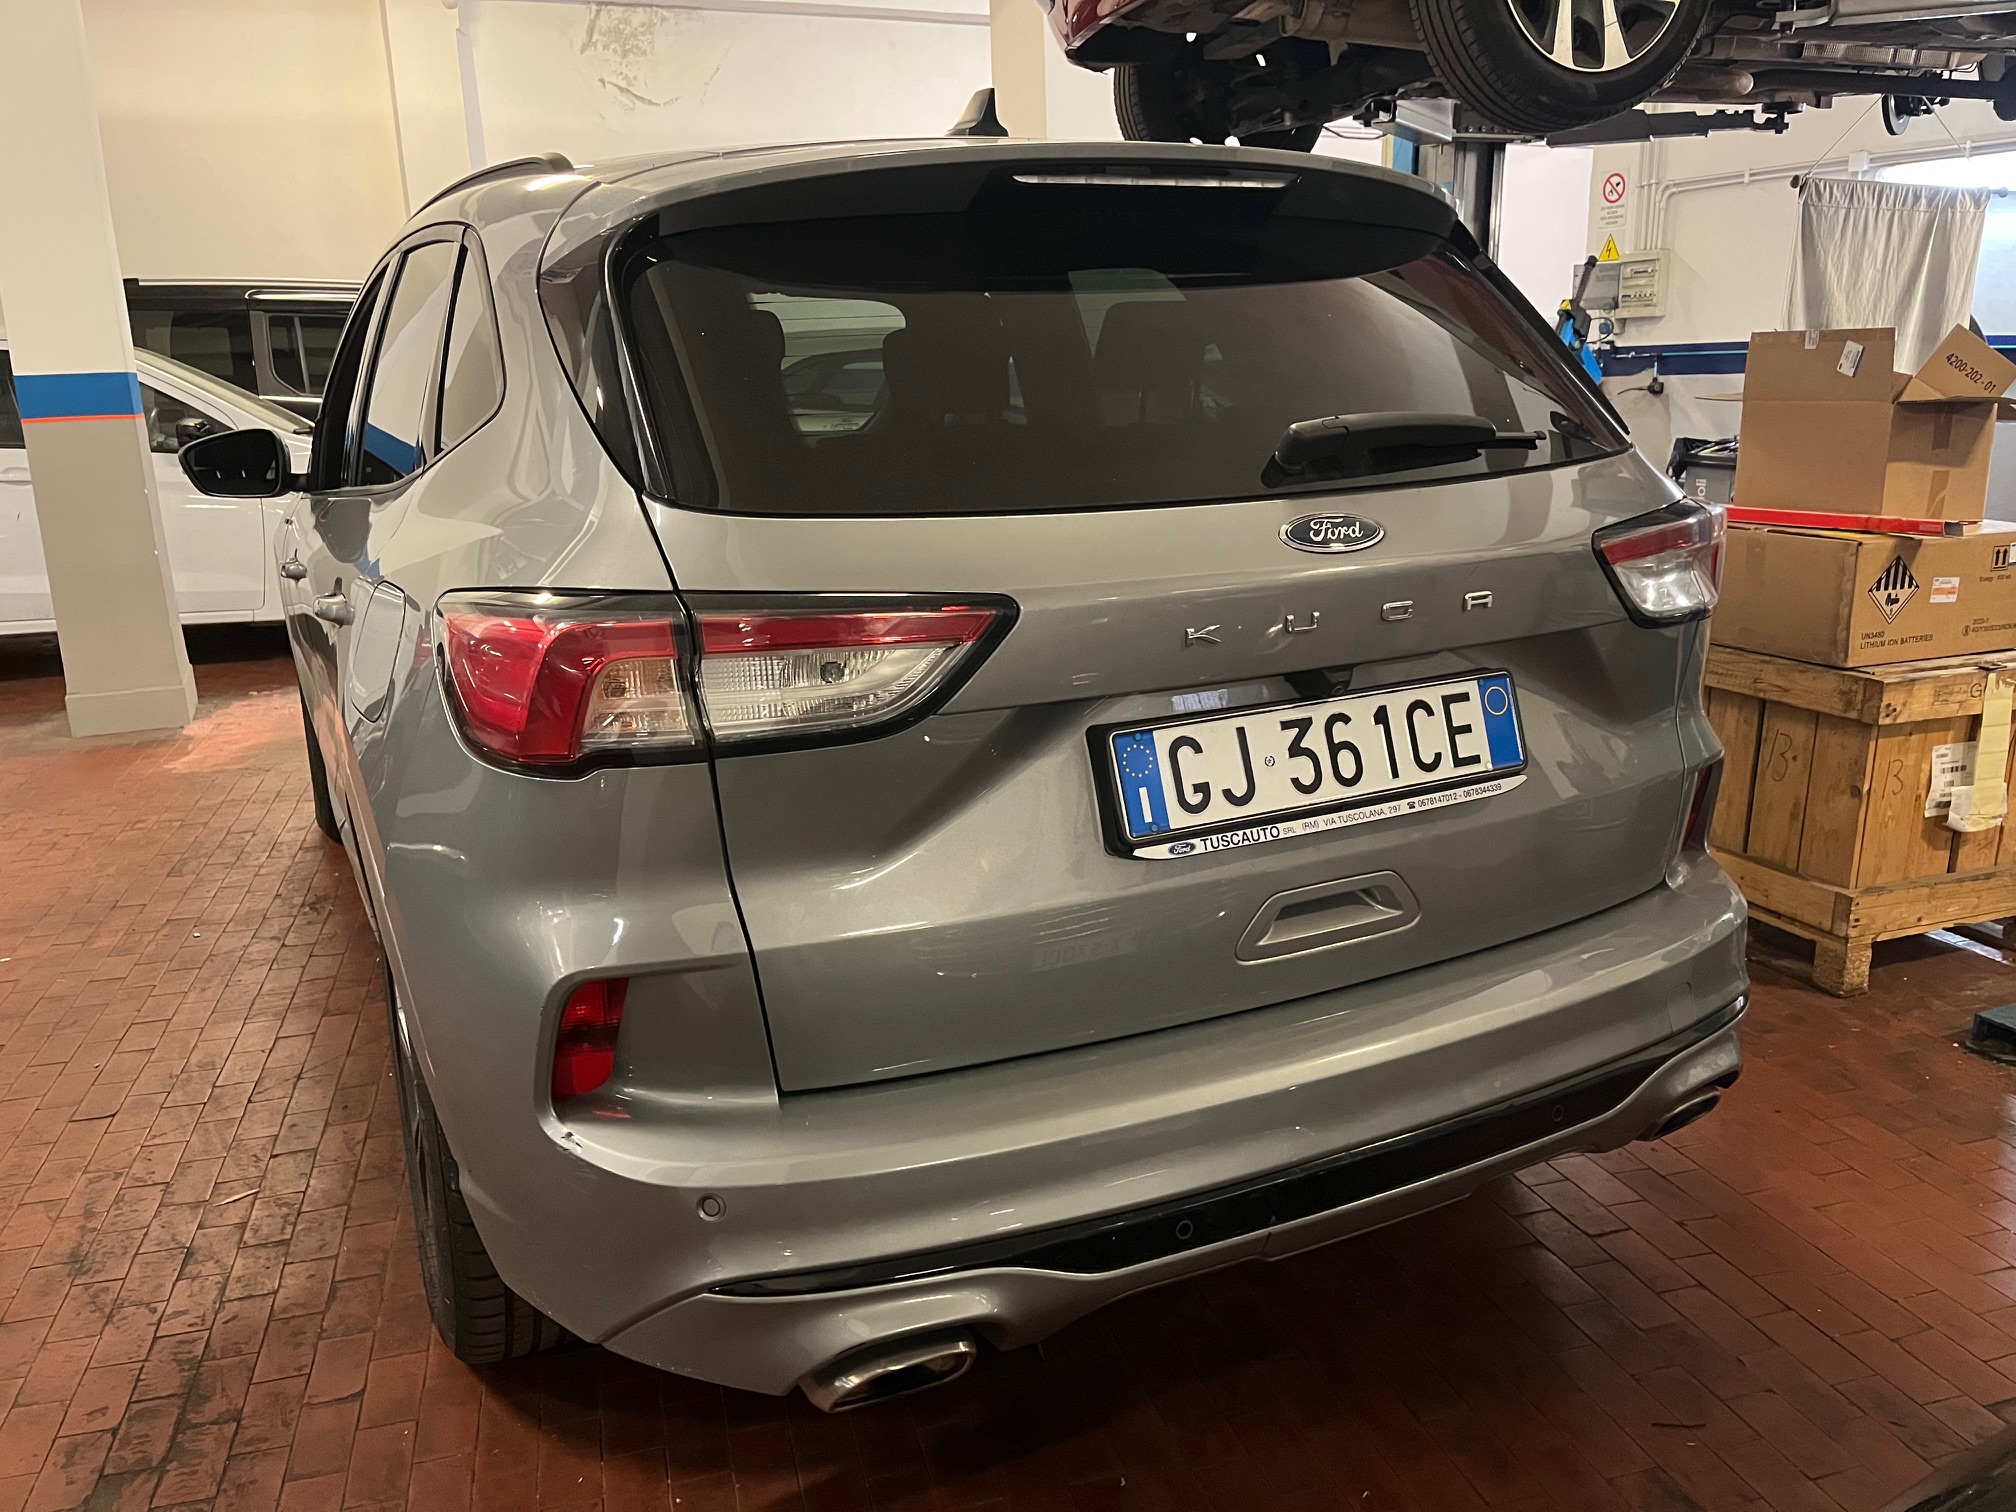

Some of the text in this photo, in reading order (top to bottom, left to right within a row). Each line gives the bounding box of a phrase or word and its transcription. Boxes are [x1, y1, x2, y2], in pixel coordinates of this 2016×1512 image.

[1309, 518, 1364, 542] Ford
[1184, 590, 1493, 647] KUGA
[1860, 634, 1934, 649] LITHIUM ION BATTERIES
[1168, 692, 1483, 815] GJ 361CE
[1138, 787, 1153, 823] I
[1200, 825, 1281, 852] TUSCAUTO
[1282, 827, 1297, 835] SRL
[1301, 821, 1320, 832] (RM)
[1323, 817, 1337, 827] VIA
[1338, 808, 1388, 824] TUSCOLANA,
[1388, 804, 1401, 814] 297
[1417, 792, 1458, 808] 0678147012
[1463, 783, 1502, 799] 0678344339
